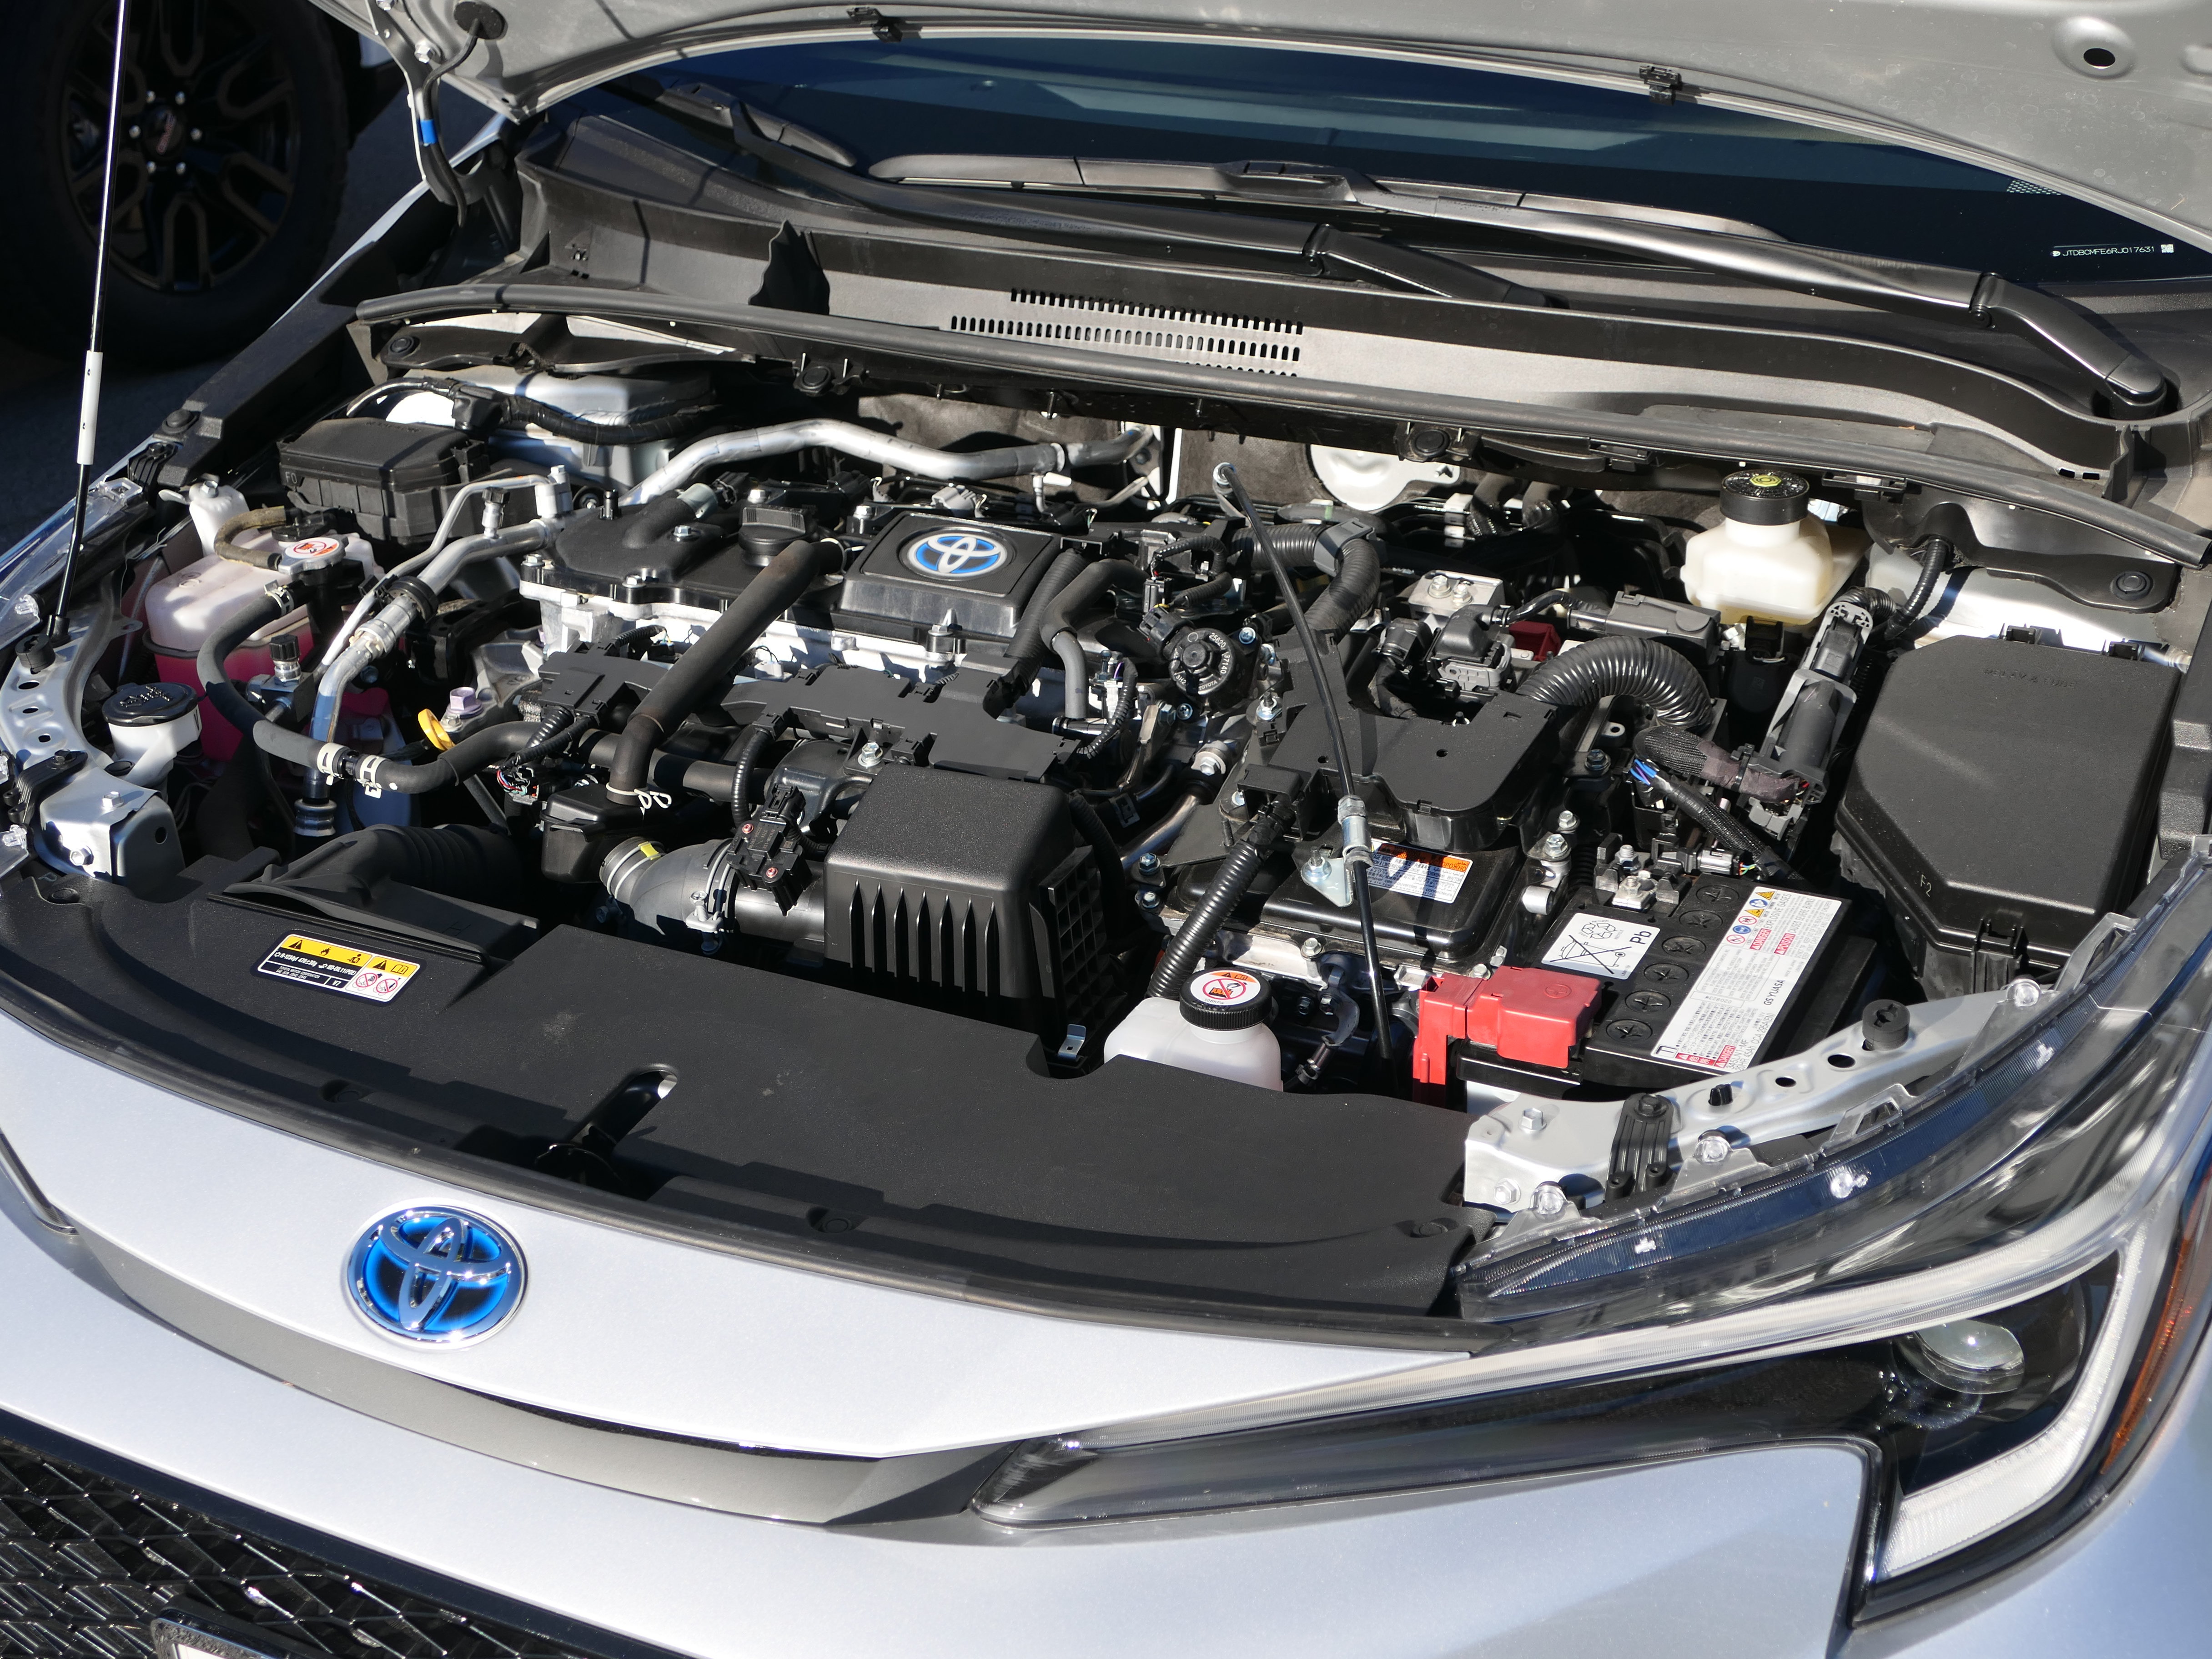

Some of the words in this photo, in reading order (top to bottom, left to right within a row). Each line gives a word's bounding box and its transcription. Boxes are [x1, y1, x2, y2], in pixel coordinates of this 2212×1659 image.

[1209, 633, 1226, 648] 25620
[1221, 654, 1230, 674] 37140
[1176, 674, 1186, 685] 3H2
[1199, 680, 1218, 690] TOYOTA
[1920, 874, 1932, 897] F2
[1753, 929, 1770, 946] DANGER
[1763, 907, 1784, 929] EXPLOSIVE
[1777, 893, 1792, 907] GASES
[1629, 931, 1652, 945] Pb
[1778, 934, 1795, 950] POISON
[1768, 980, 1785, 996] YUASA
[1757, 1013, 1775, 1033] 295A(EN)
[1751, 1034, 1764, 1044] CCA
[1718, 1046, 1734, 1062] DANGER
[1726, 1039, 1748, 1069] 345LN1-MF
[1743, 1046, 1756, 1057] 45Ah
